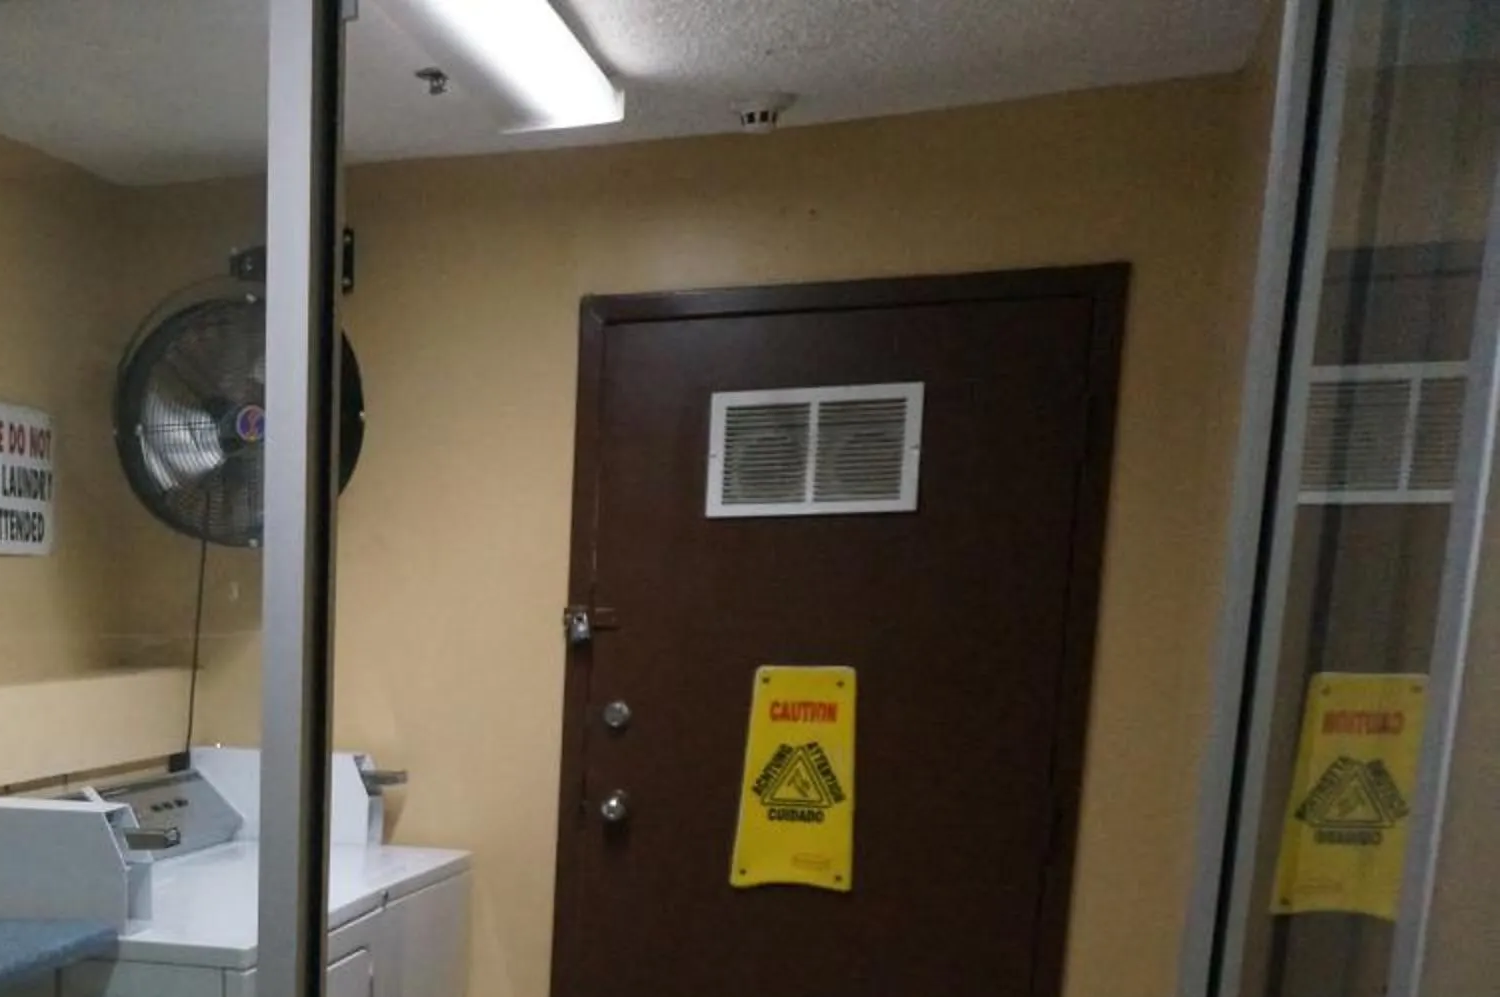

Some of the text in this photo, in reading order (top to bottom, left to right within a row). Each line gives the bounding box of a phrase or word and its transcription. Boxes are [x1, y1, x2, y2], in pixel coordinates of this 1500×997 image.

[8, 422, 26, 456] DO
[29, 425, 53, 461] NOT
[2, 463, 53, 502] LAUNDRY
[769, 701, 838, 723] CAUTION
[767, 808, 825, 823] CUIDADO
